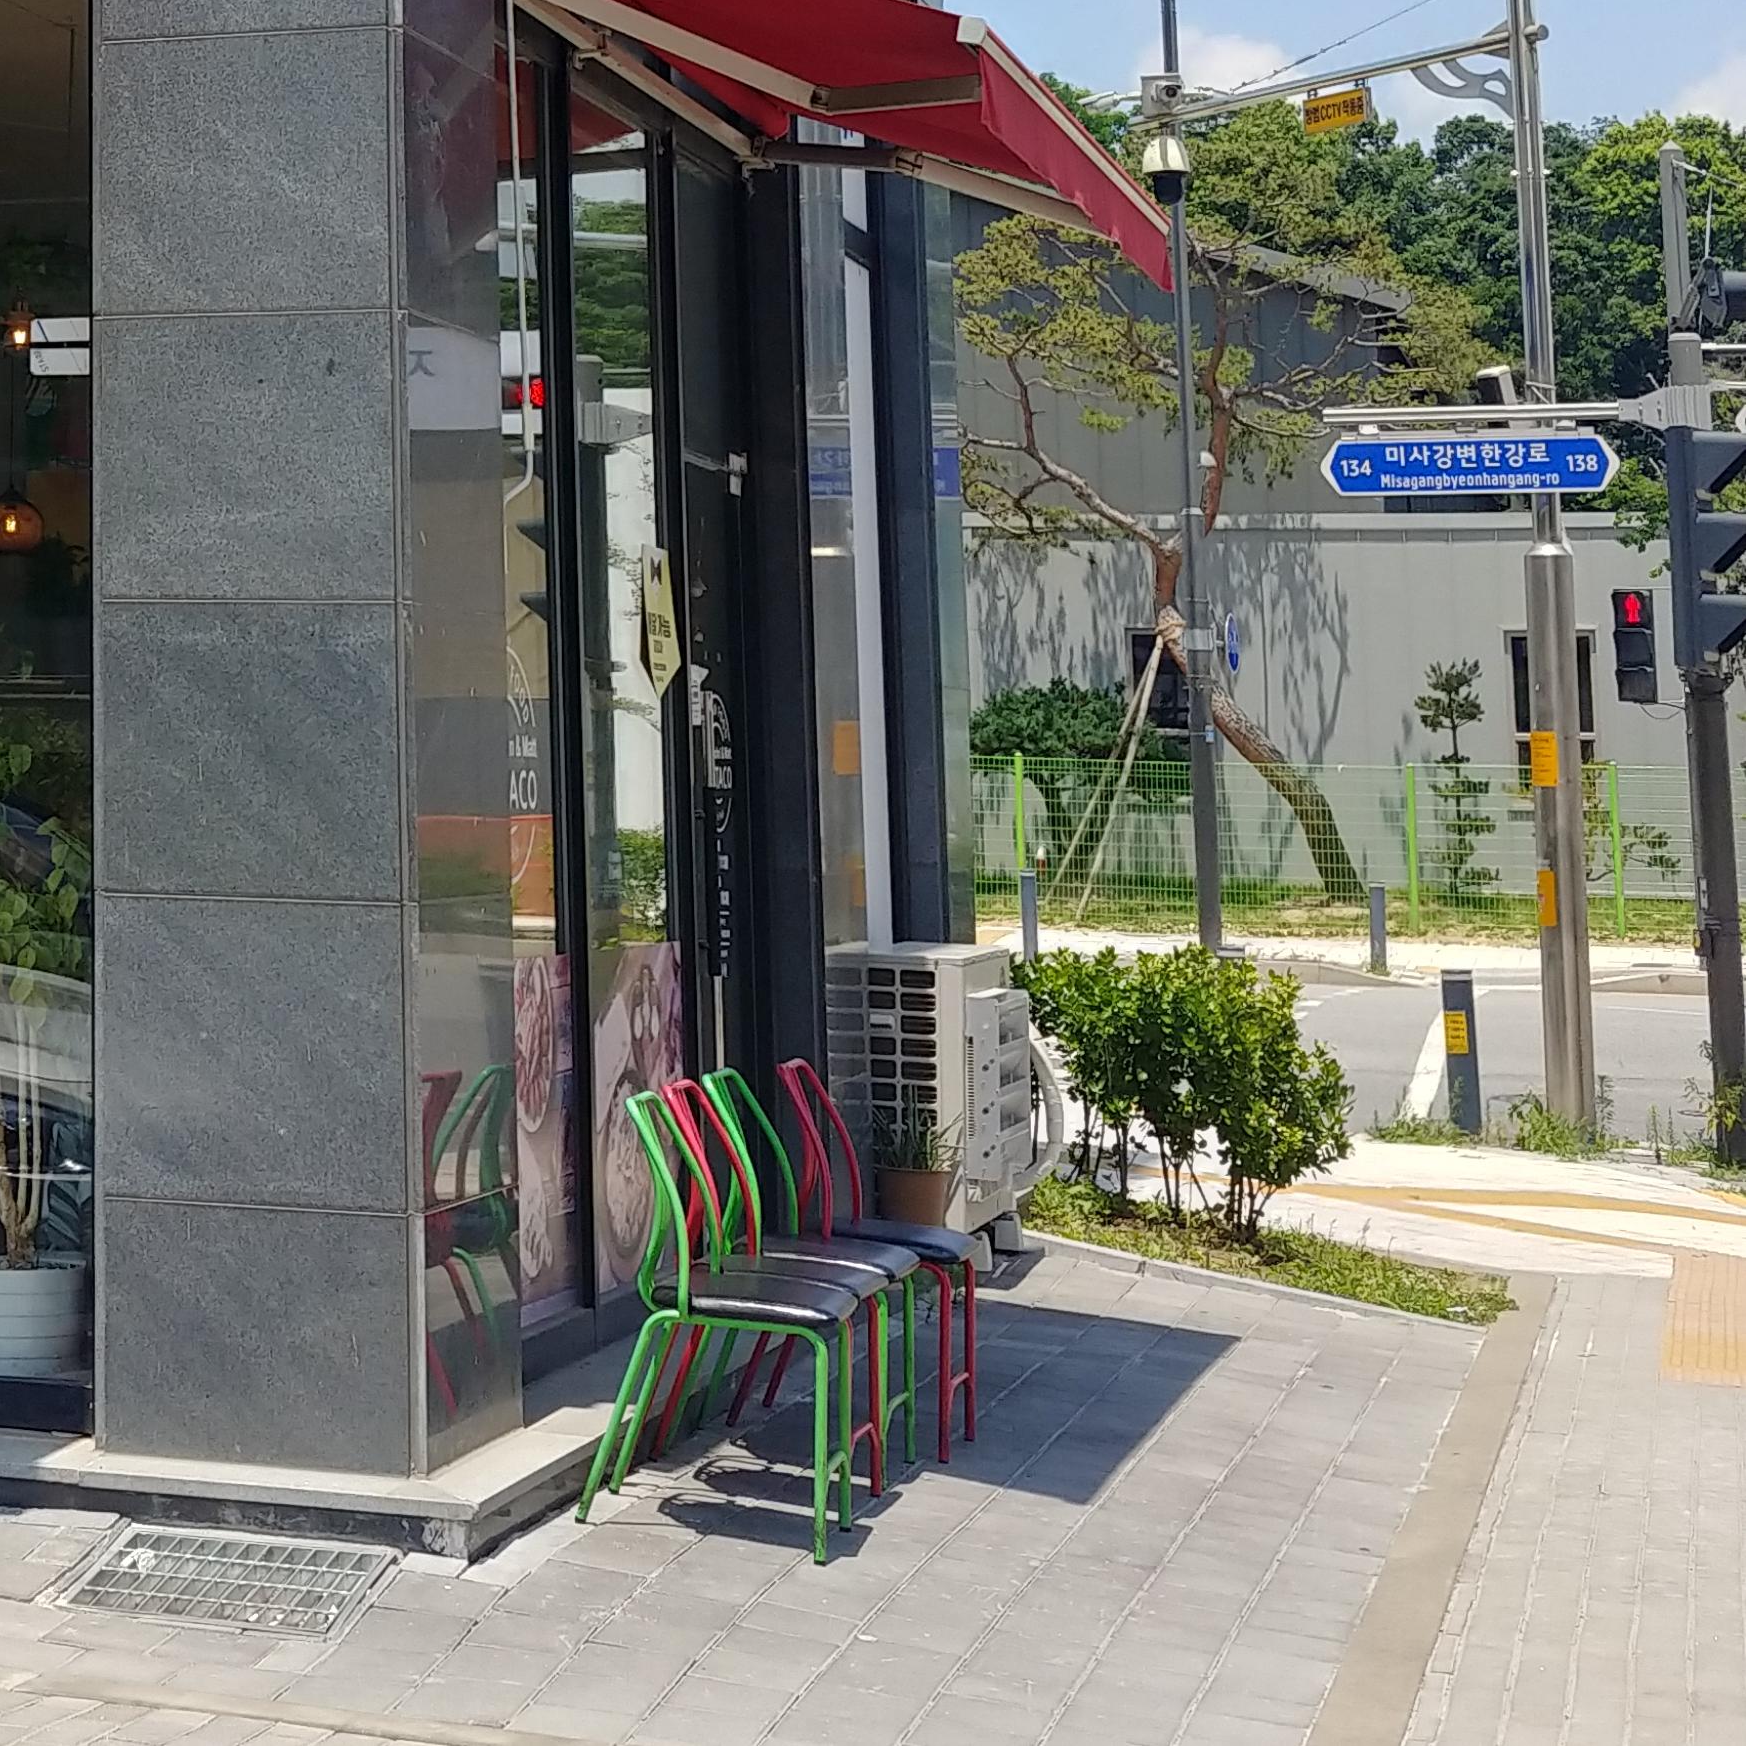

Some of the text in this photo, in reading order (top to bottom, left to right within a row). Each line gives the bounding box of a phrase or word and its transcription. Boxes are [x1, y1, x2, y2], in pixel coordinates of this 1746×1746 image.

[1340, 443, 1599, 477] 134 미사강변한강로 138
[1380, 472, 1561, 490] Misagangbyeonhangang-ro
[509, 769, 538, 810] ACO
